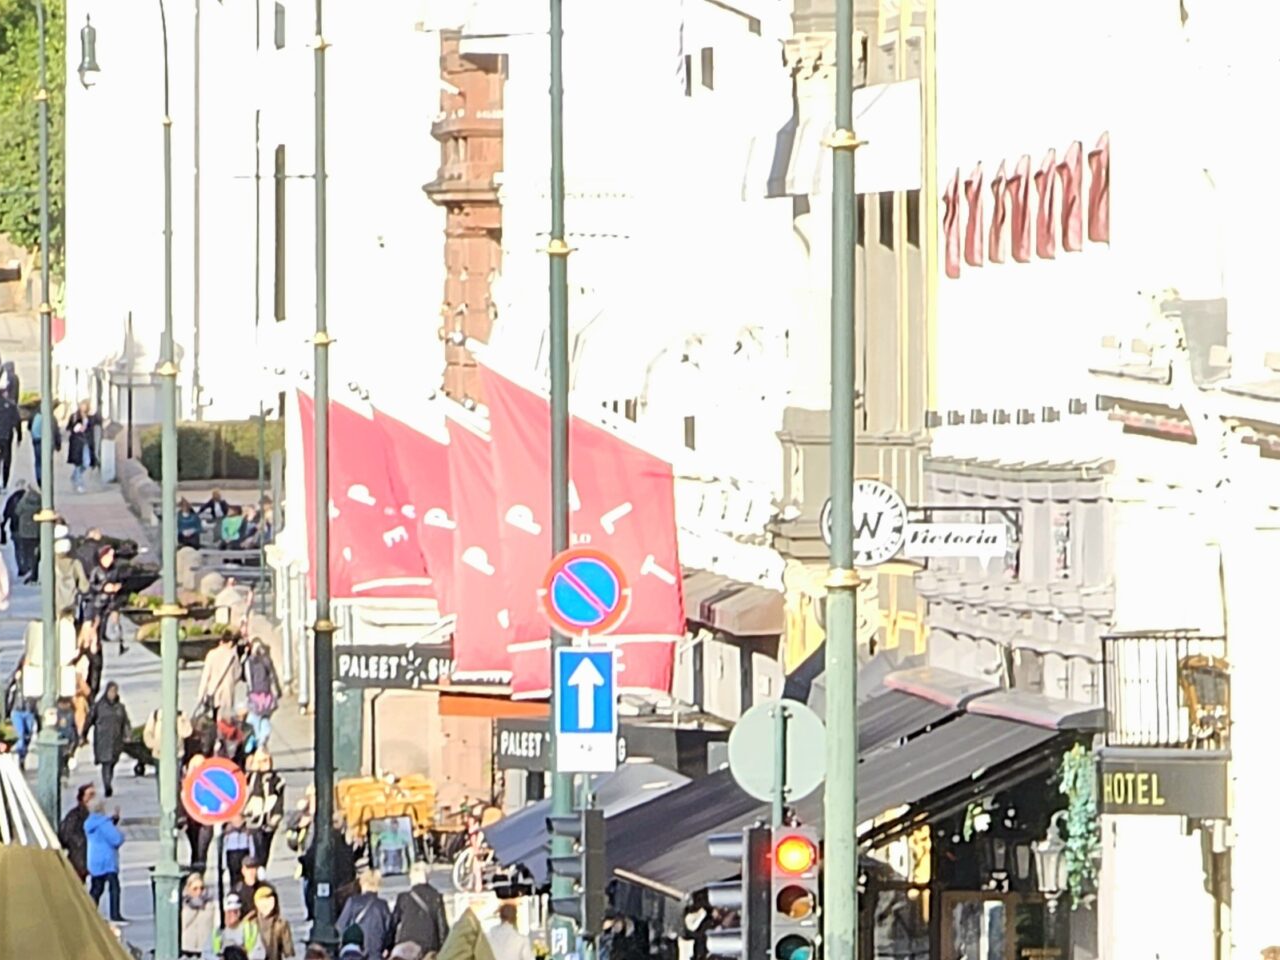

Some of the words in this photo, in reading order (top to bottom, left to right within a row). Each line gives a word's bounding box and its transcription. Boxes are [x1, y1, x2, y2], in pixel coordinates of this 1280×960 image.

[910, 529, 998, 545] Victoria
[339, 654, 399, 679] PALEET
[500, 730, 542, 758] PALEET
[1103, 772, 1166, 806] HOTEL
